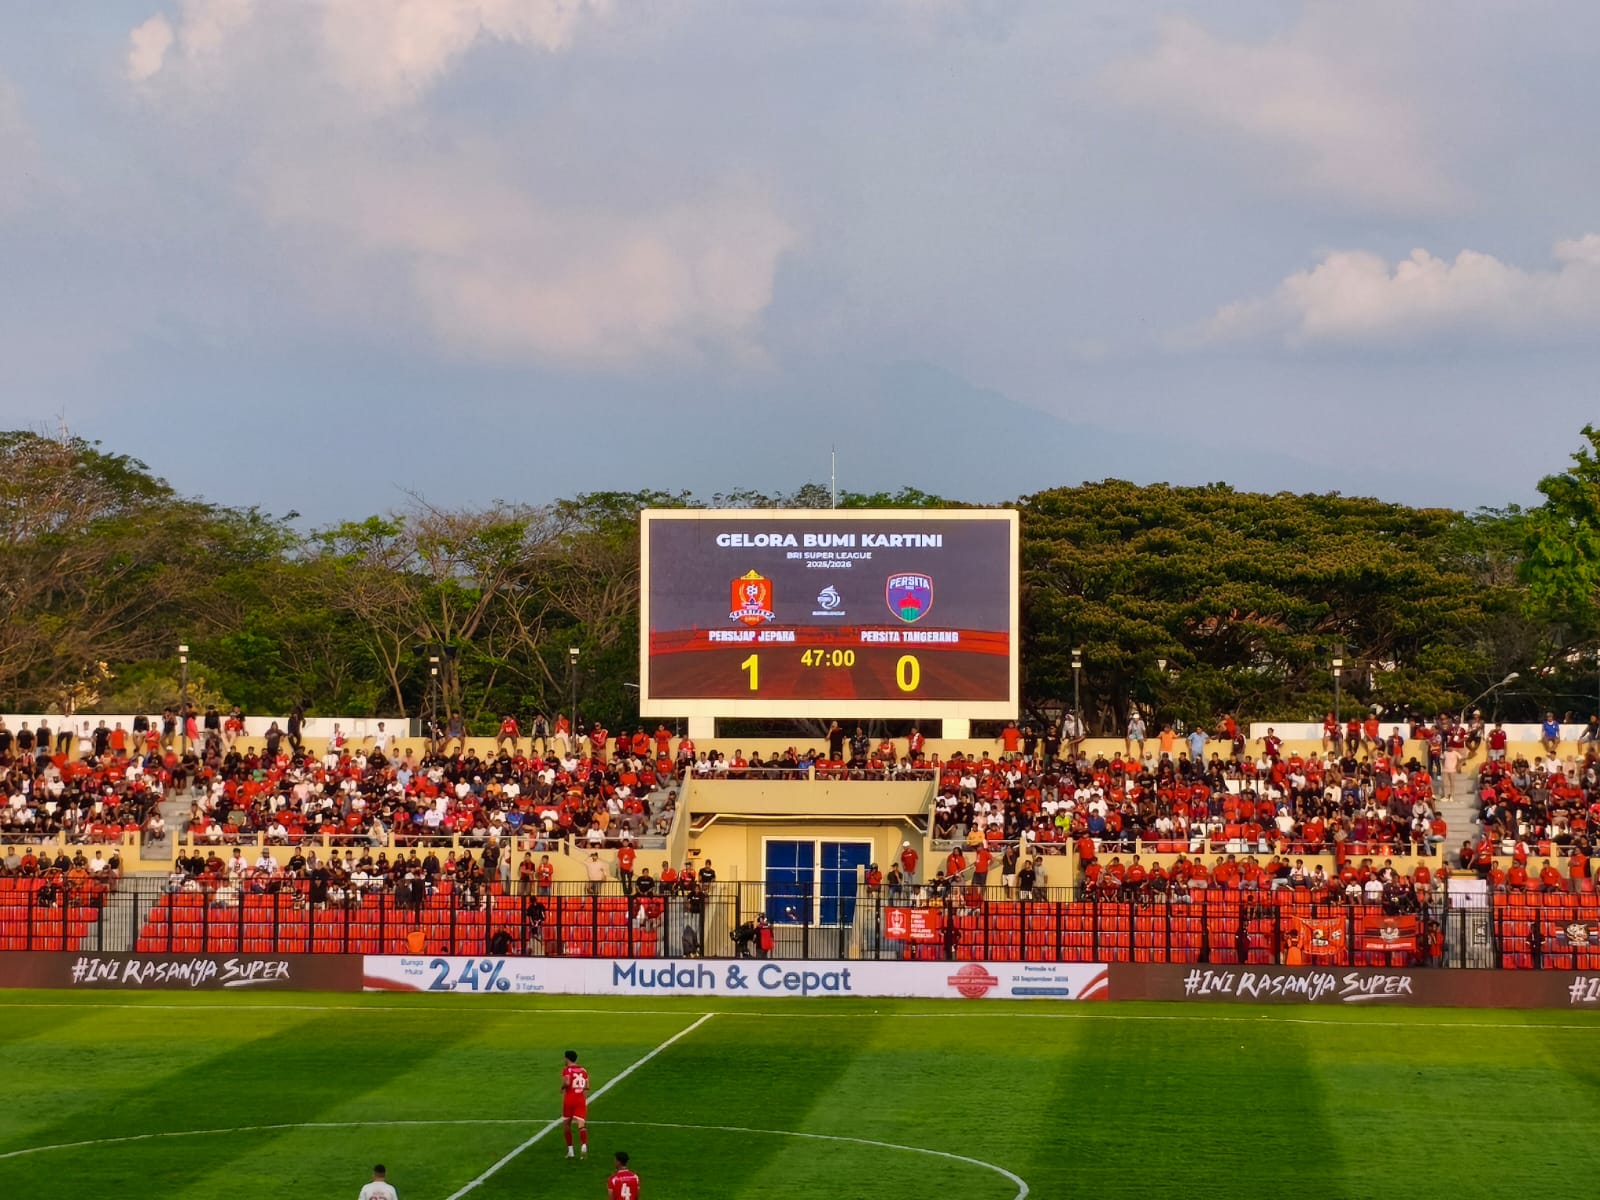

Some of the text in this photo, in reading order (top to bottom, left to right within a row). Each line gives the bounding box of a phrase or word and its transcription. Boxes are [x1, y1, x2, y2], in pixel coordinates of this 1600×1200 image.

[716, 533, 943, 548] GELORA BUMI KARTINI
[806, 560, 852, 568] 2025/2026
[836, 552, 872, 560] LEAGUE
[889, 576, 930, 590] PERSITA
[708, 630, 796, 642] PERSIJAP JEPARA
[861, 630, 959, 643] PERSITA TANGERANG
[800, 649, 855, 668] 47:00
[741, 654, 759, 691] 1
[896, 654, 920, 692] 0
[219, 958, 290, 981] SUPER
[428, 958, 511, 991] 2,4%
[612, 961, 852, 995] Mudah & Cepat
[1339, 972, 1413, 996] SUPER
[1568, 976, 1600, 1004] #I
[572, 1072, 586, 1089] 26
[620, 1183, 632, 1200] 4
